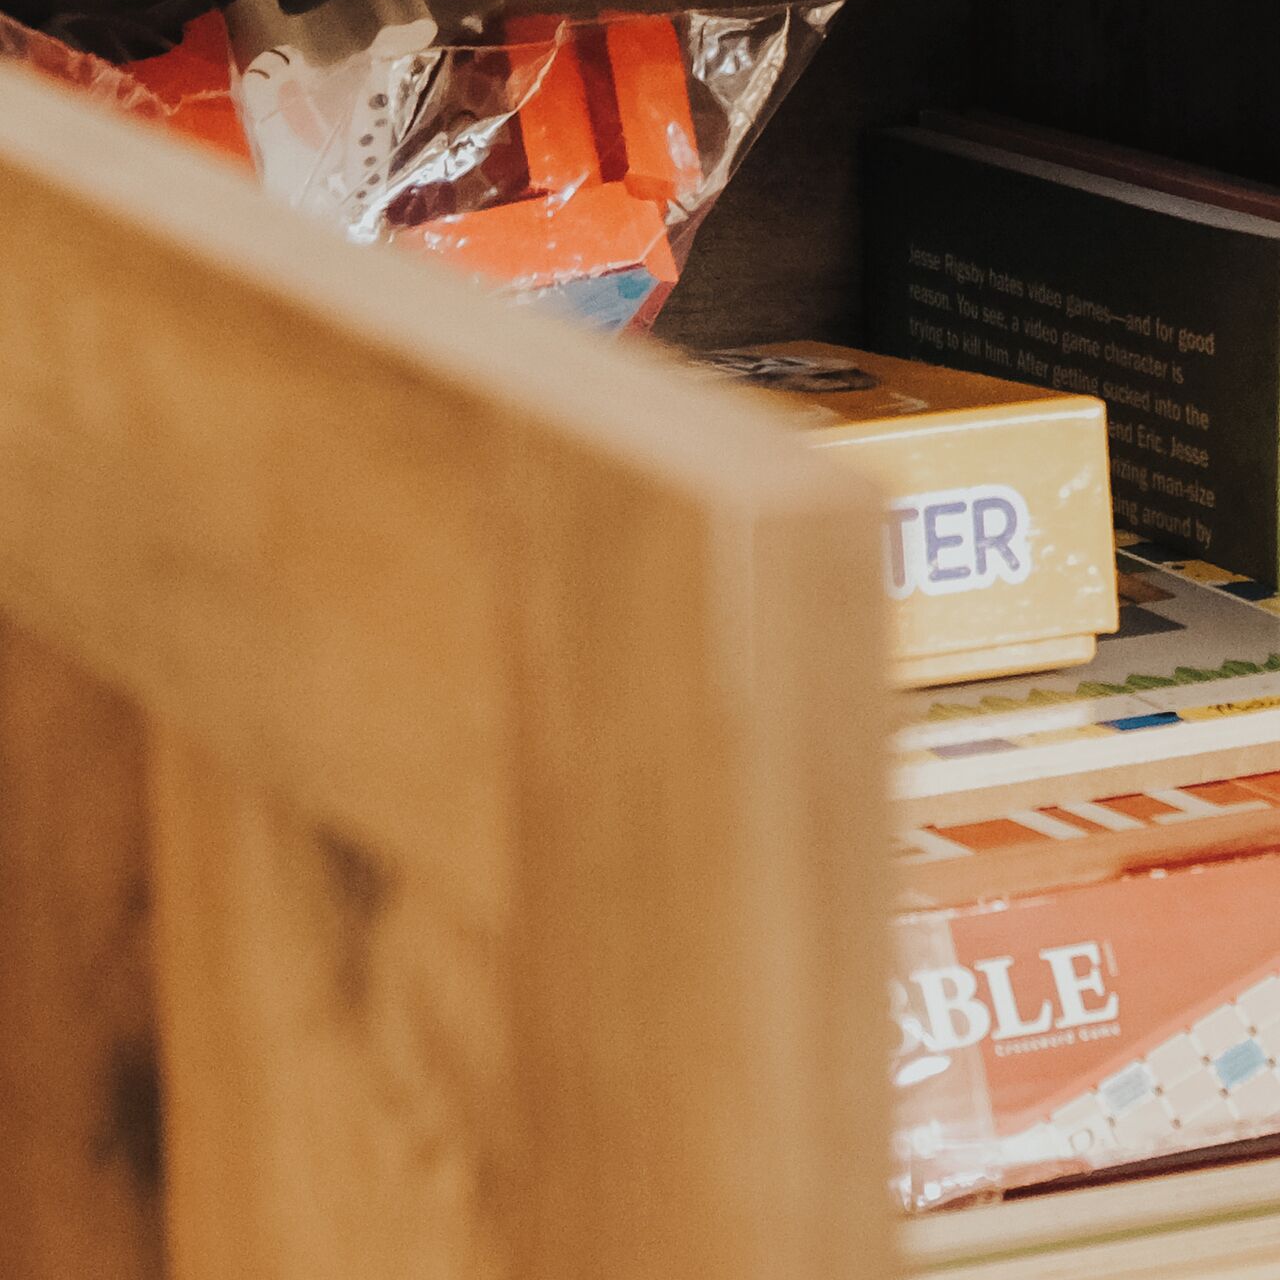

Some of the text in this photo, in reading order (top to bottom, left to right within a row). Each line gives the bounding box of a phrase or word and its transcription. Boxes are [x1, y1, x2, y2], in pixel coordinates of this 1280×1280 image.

[956, 293, 979, 320] You
[1011, 316, 1021, 333] a
[1023, 316, 1059, 345] video
[1061, 330, 1101, 361] game
[1171, 362, 1185, 386] is
[1027, 280, 1063, 310] video
[1155, 317, 1175, 343] for
[1177, 328, 1216, 356] good
[1016, 350, 1050, 379] After
[1102, 380, 1151, 412] sucked
[1154, 394, 1182, 422] into
[1184, 404, 1211, 432] the
[1152, 470, 1217, 508] man-size
[1169, 436, 1211, 469] Jesse
[886, 496, 1021, 587] TER
[1142, 506, 1193, 539] around
[1195, 521, 1213, 549] by
